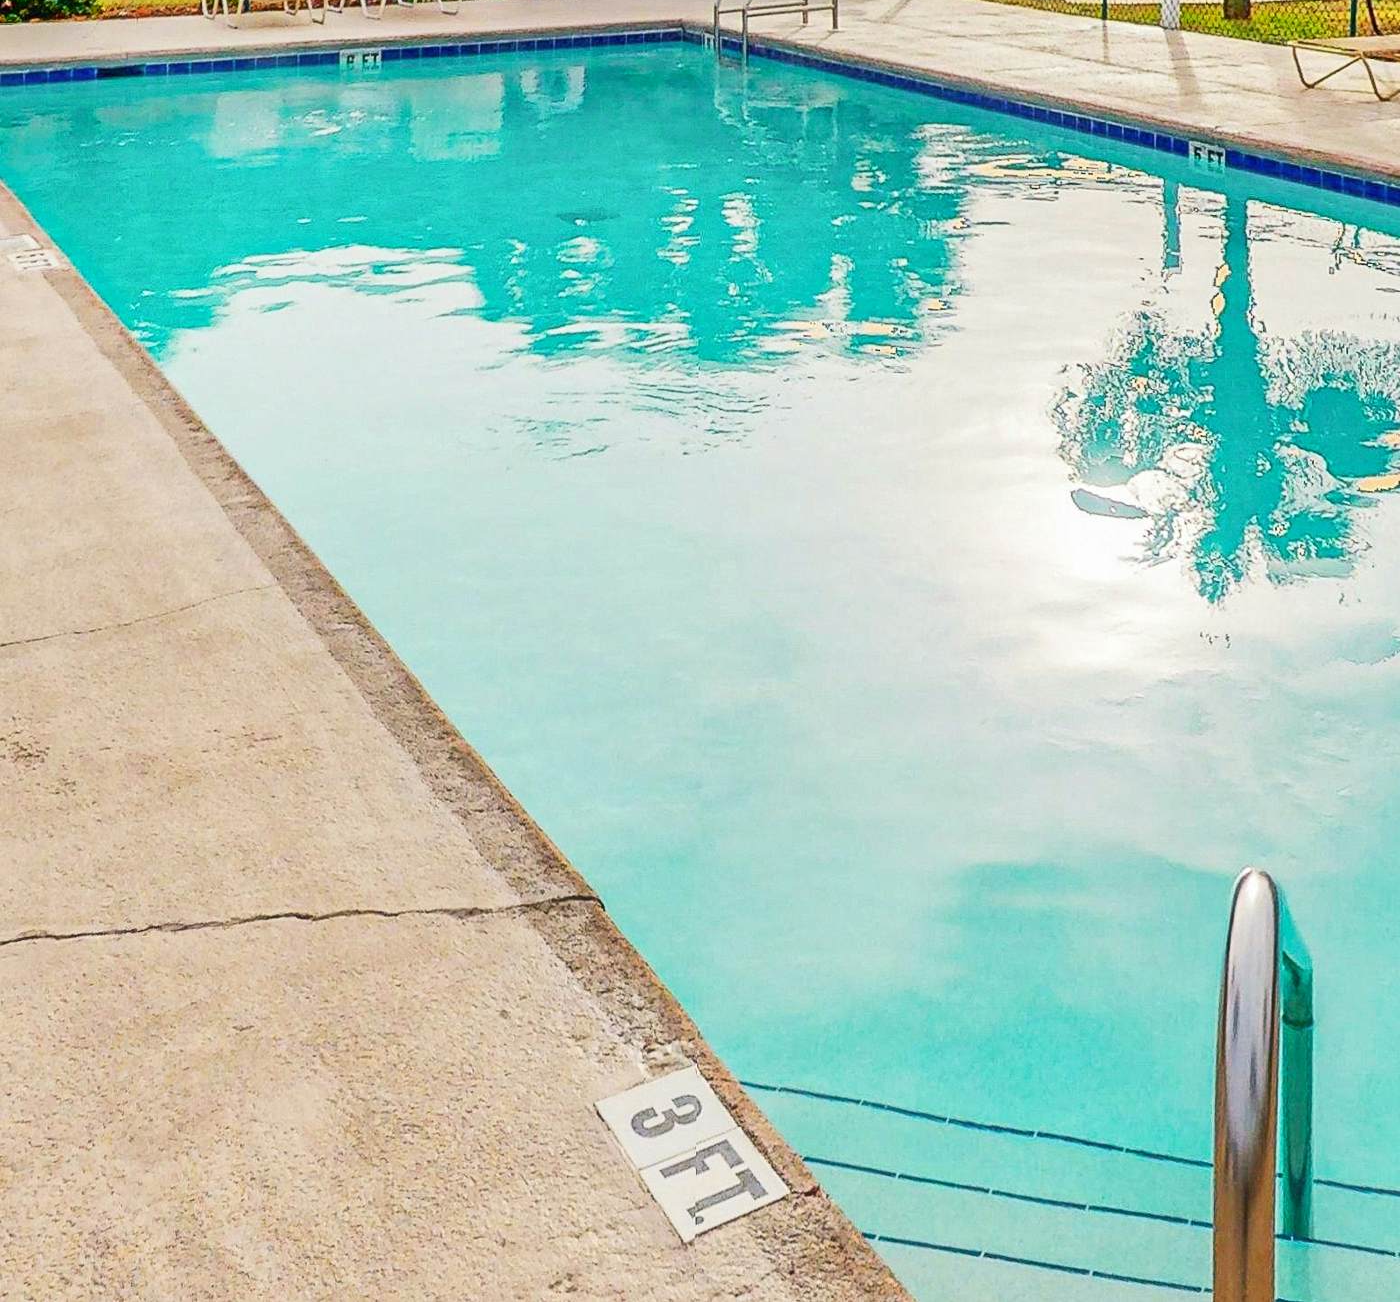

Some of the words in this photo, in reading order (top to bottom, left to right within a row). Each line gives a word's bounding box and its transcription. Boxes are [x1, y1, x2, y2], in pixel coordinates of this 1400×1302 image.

[362, 52, 379, 66] FT
[1207, 149, 1224, 165] FT
[631, 1094, 703, 1138] 3
